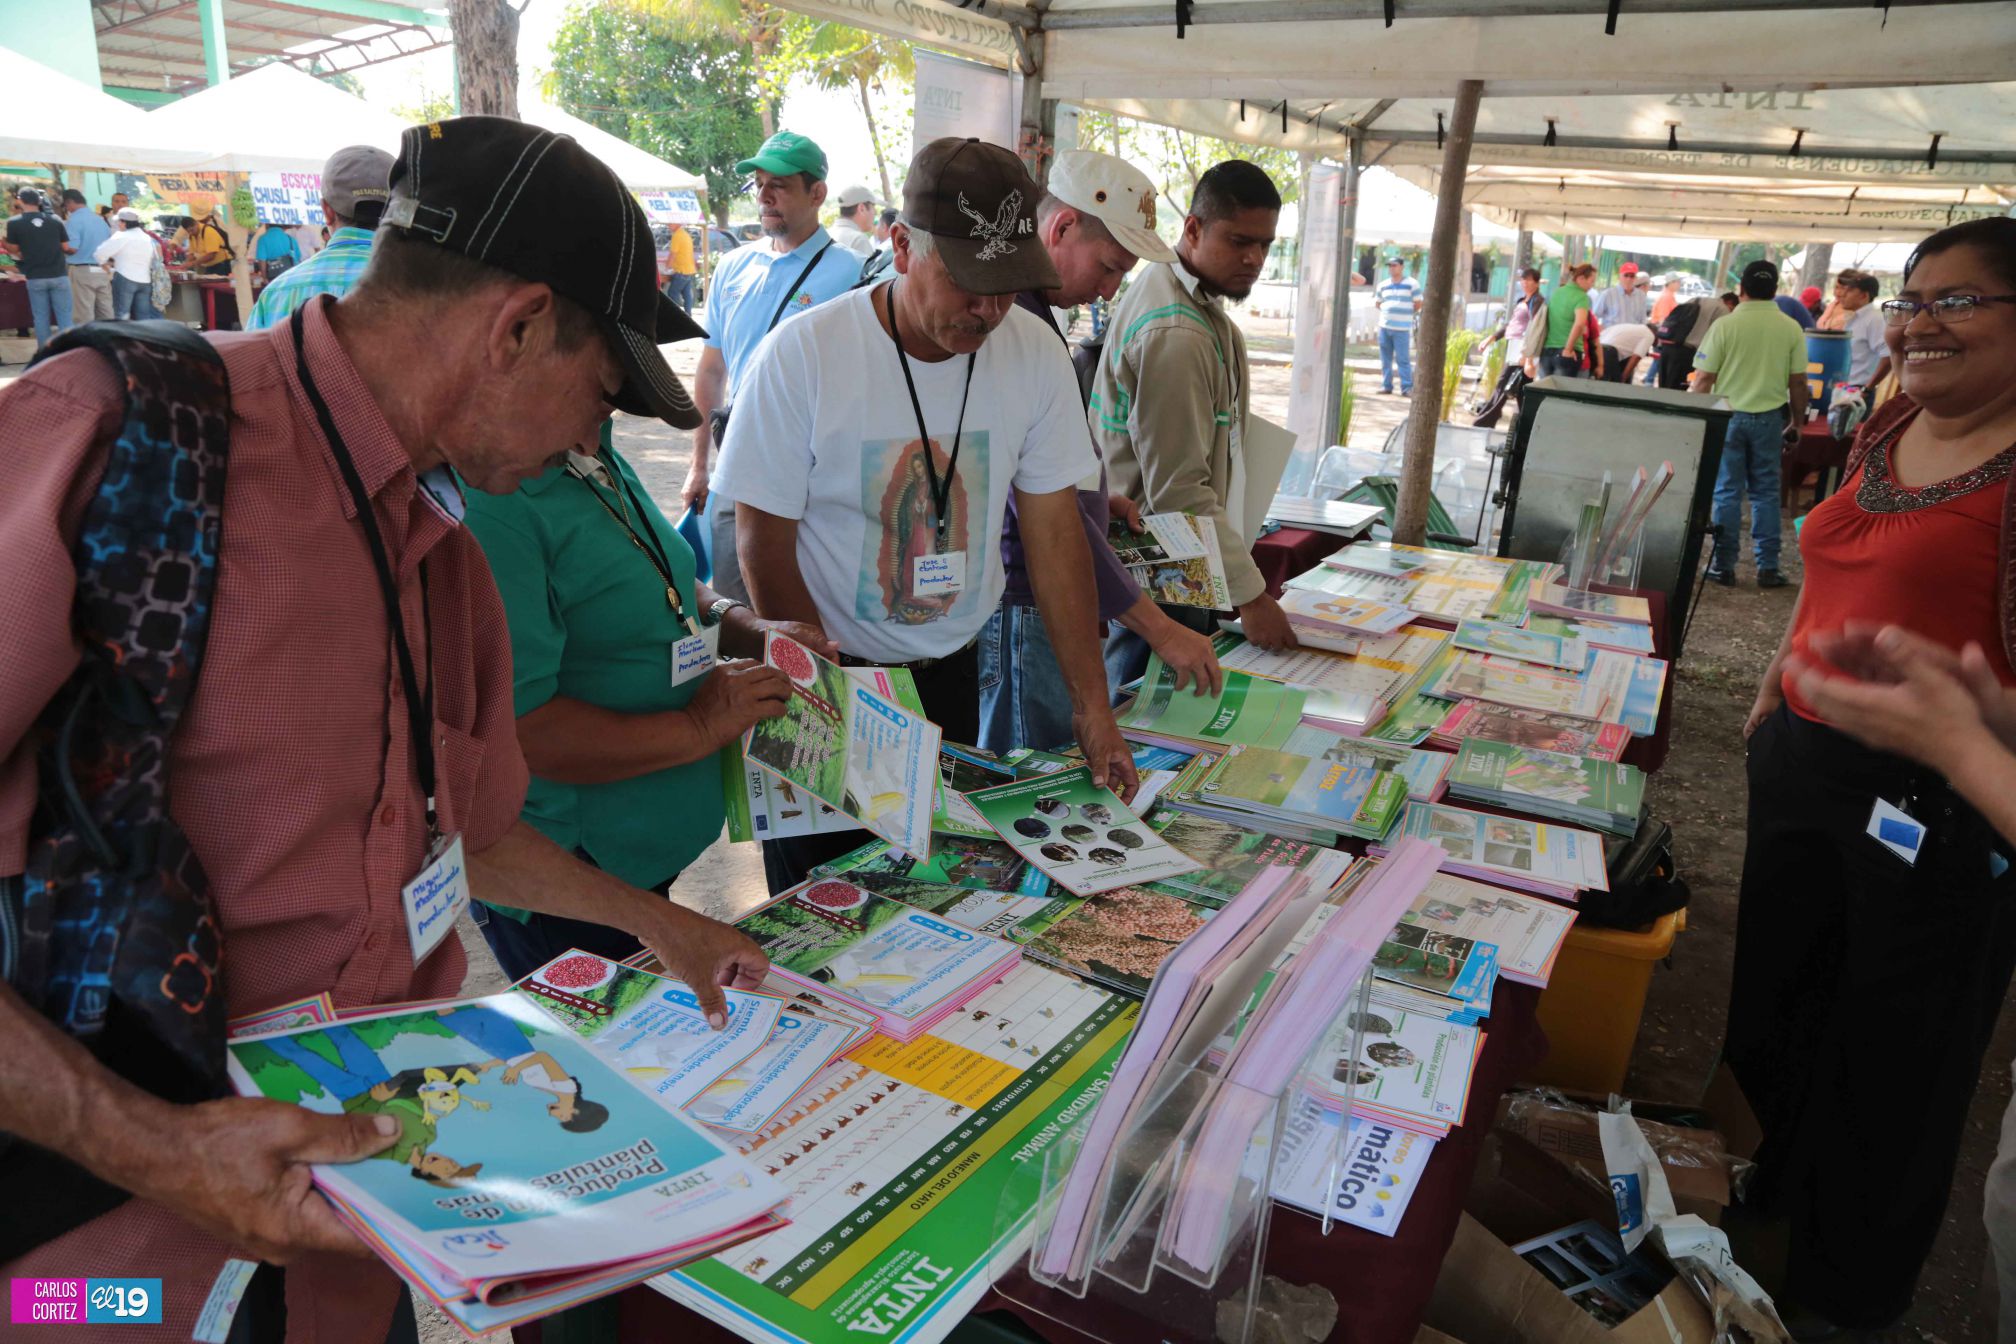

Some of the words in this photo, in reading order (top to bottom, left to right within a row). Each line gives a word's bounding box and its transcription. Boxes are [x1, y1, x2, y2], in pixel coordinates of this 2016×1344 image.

[158, 178, 191, 191] PIEDRA
[751, 771, 762, 799] INTA
[727, 999, 760, 1043] Siembre
[798, 1021, 828, 1051] Siembre
[684, 1038, 730, 1074] variedades
[760, 1047, 802, 1087] variedades
[722, 1081, 765, 1124] mejoradas
[991, 1077, 1032, 1113] ACTIVIDADES
[1056, 1078, 1109, 1125] SANIDAD
[973, 1114, 988, 1129] ENE
[958, 1126, 973, 1141] FEB
[1010, 1122, 1063, 1163] ANIMAL
[941, 1138, 959, 1156] MZO
[530, 1140, 655, 1192] plántulas
[925, 1152, 942, 1168] ABR
[944, 1150, 980, 1181] MANEJO
[909, 1164, 926, 1182] MAY
[508, 1157, 665, 1214] Produccn
[892, 1179, 908, 1196] JUN
[930, 1175, 951, 1194] DEL
[875, 1194, 890, 1210] JUL
[909, 1188, 935, 1212] HATO
[462, 1204, 501, 1222] de
[855, 1207, 874, 1226] AGO
[838, 1223, 855, 1241] SEP
[816, 1238, 835, 1258] OCT
[795, 1254, 815, 1275] NOV
[887, 1250, 920, 1280] Instituto
[775, 1272, 793, 1291] DIC
[846, 1255, 953, 1335] INTA
[836, 1314, 847, 1324] de
